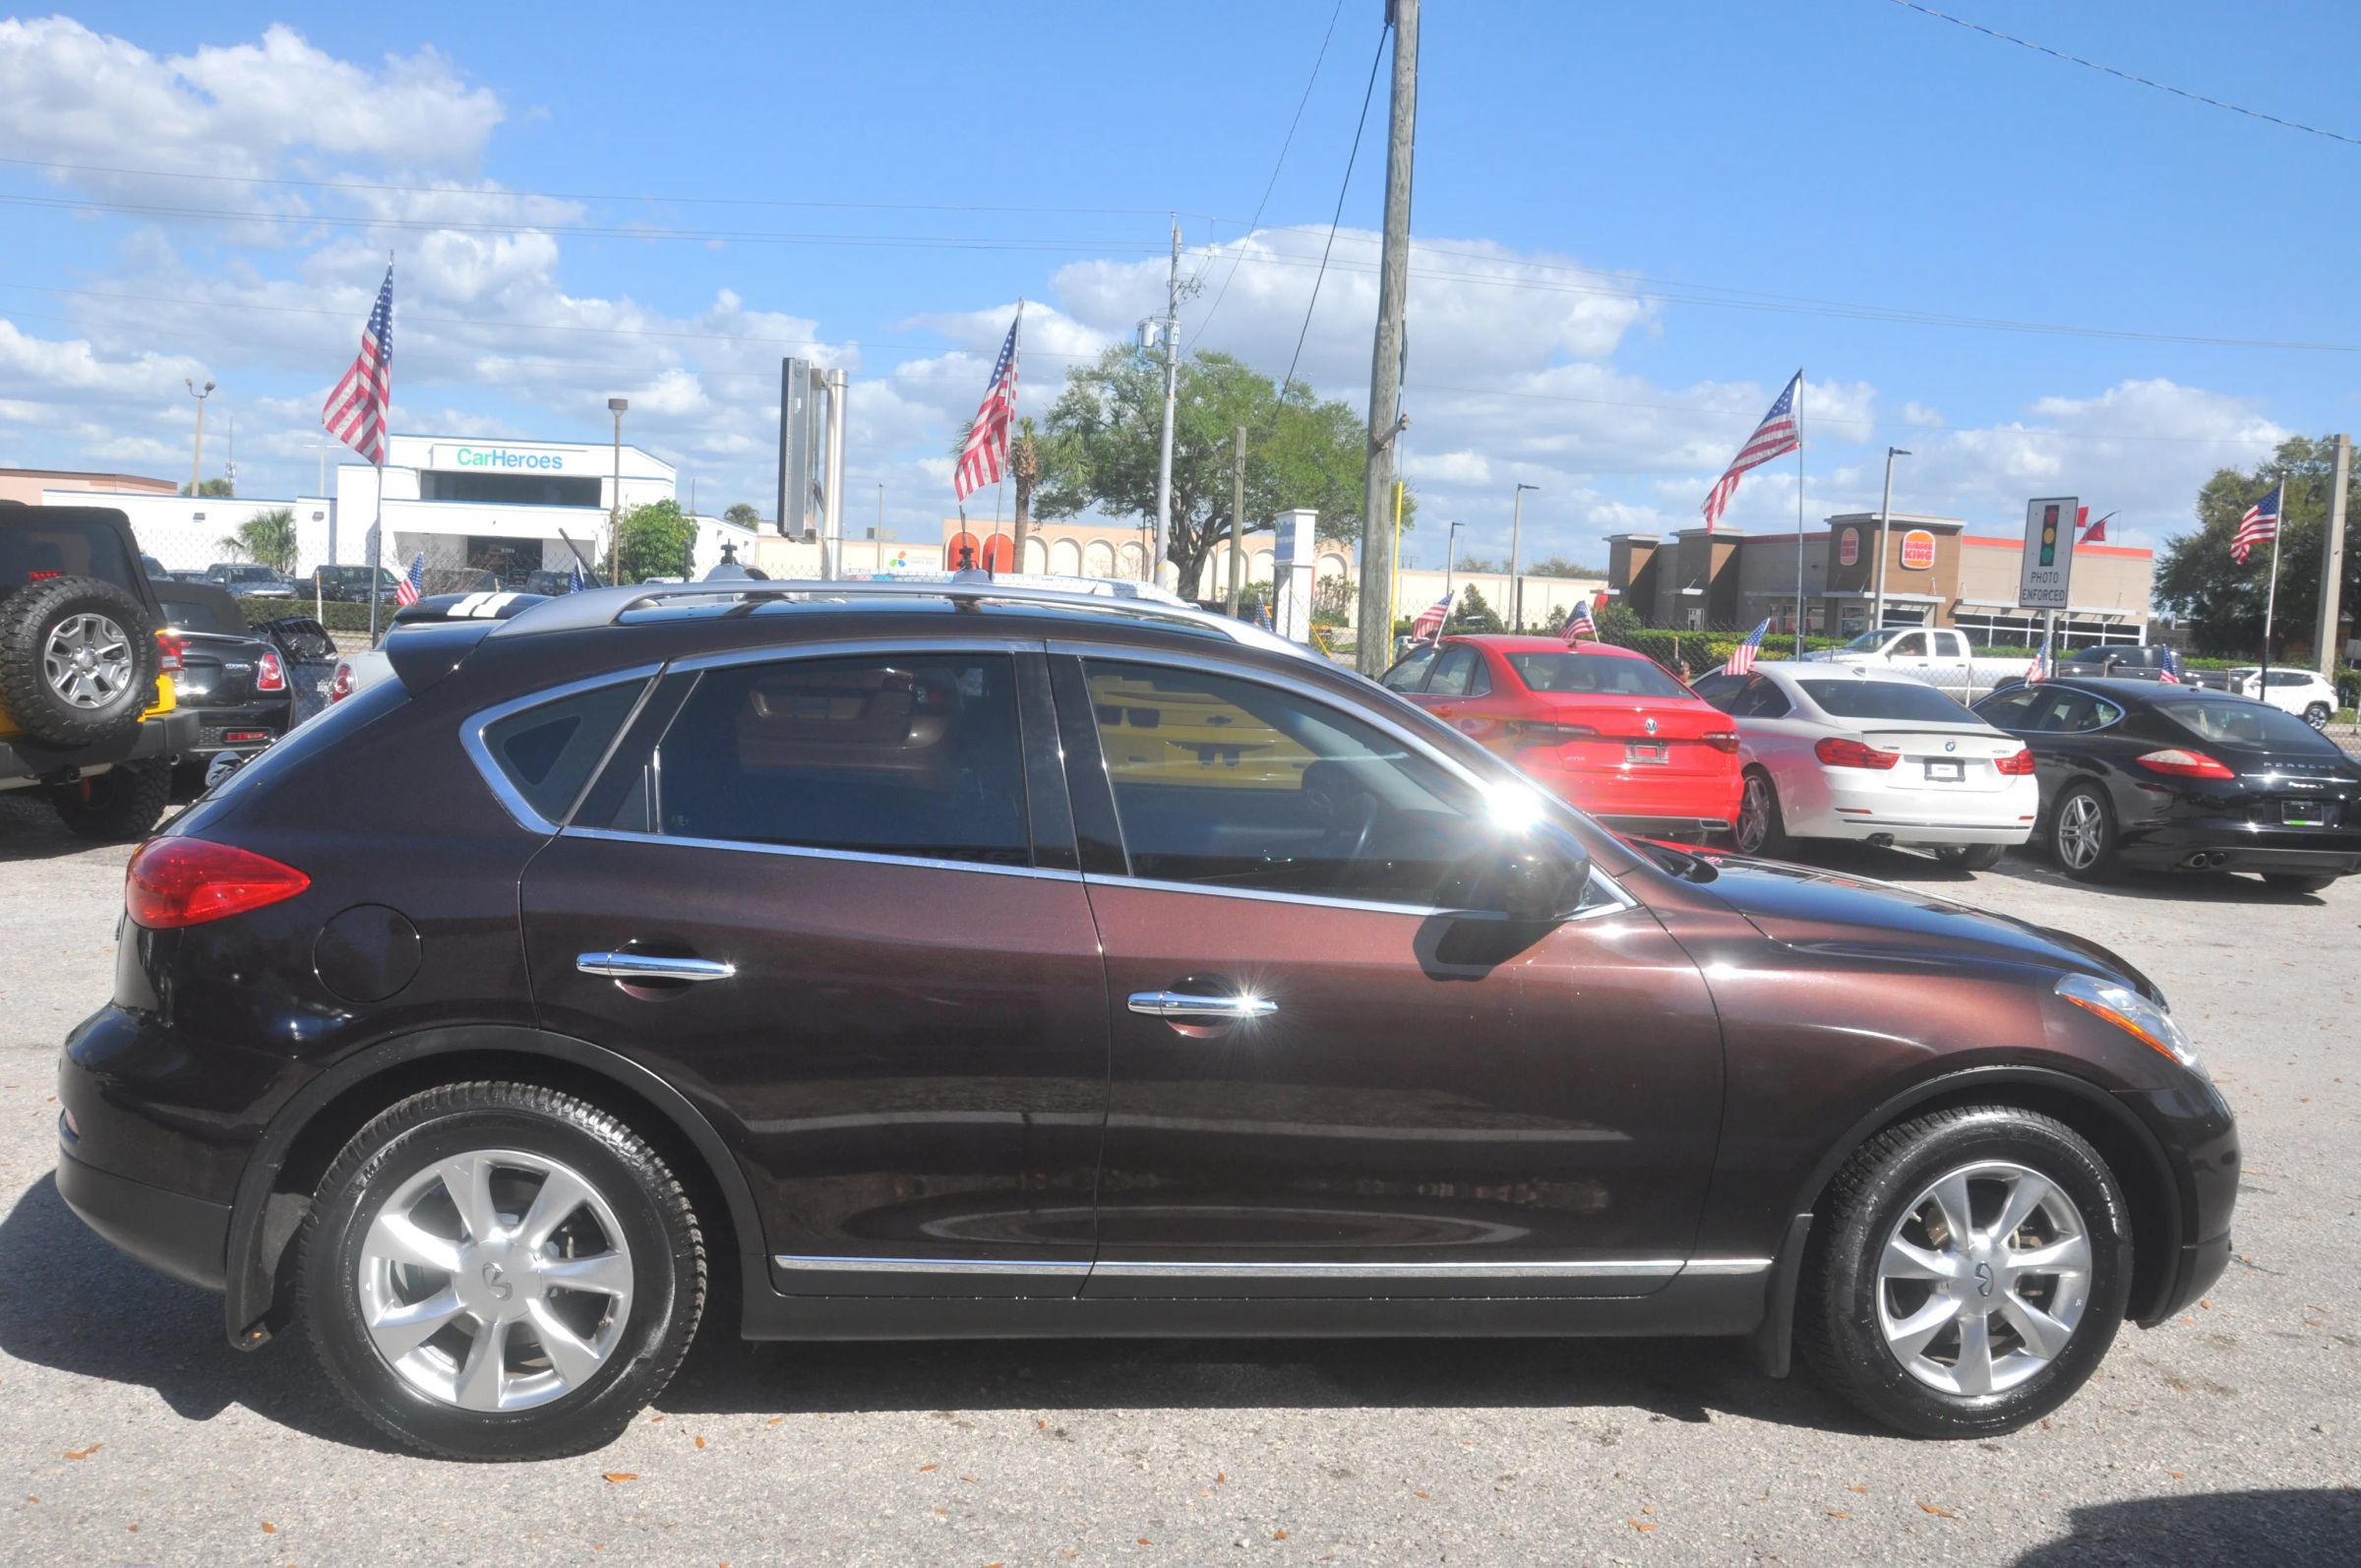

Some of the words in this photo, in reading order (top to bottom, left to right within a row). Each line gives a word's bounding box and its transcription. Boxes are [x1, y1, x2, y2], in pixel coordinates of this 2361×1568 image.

[456, 448, 564, 469] CarHeroes
[1905, 542, 1933, 551] BURGER
[1905, 550, 1933, 561] KING
[2030, 572, 2060, 583] PHOTO
[2022, 589, 2066, 601] ENFORCED
